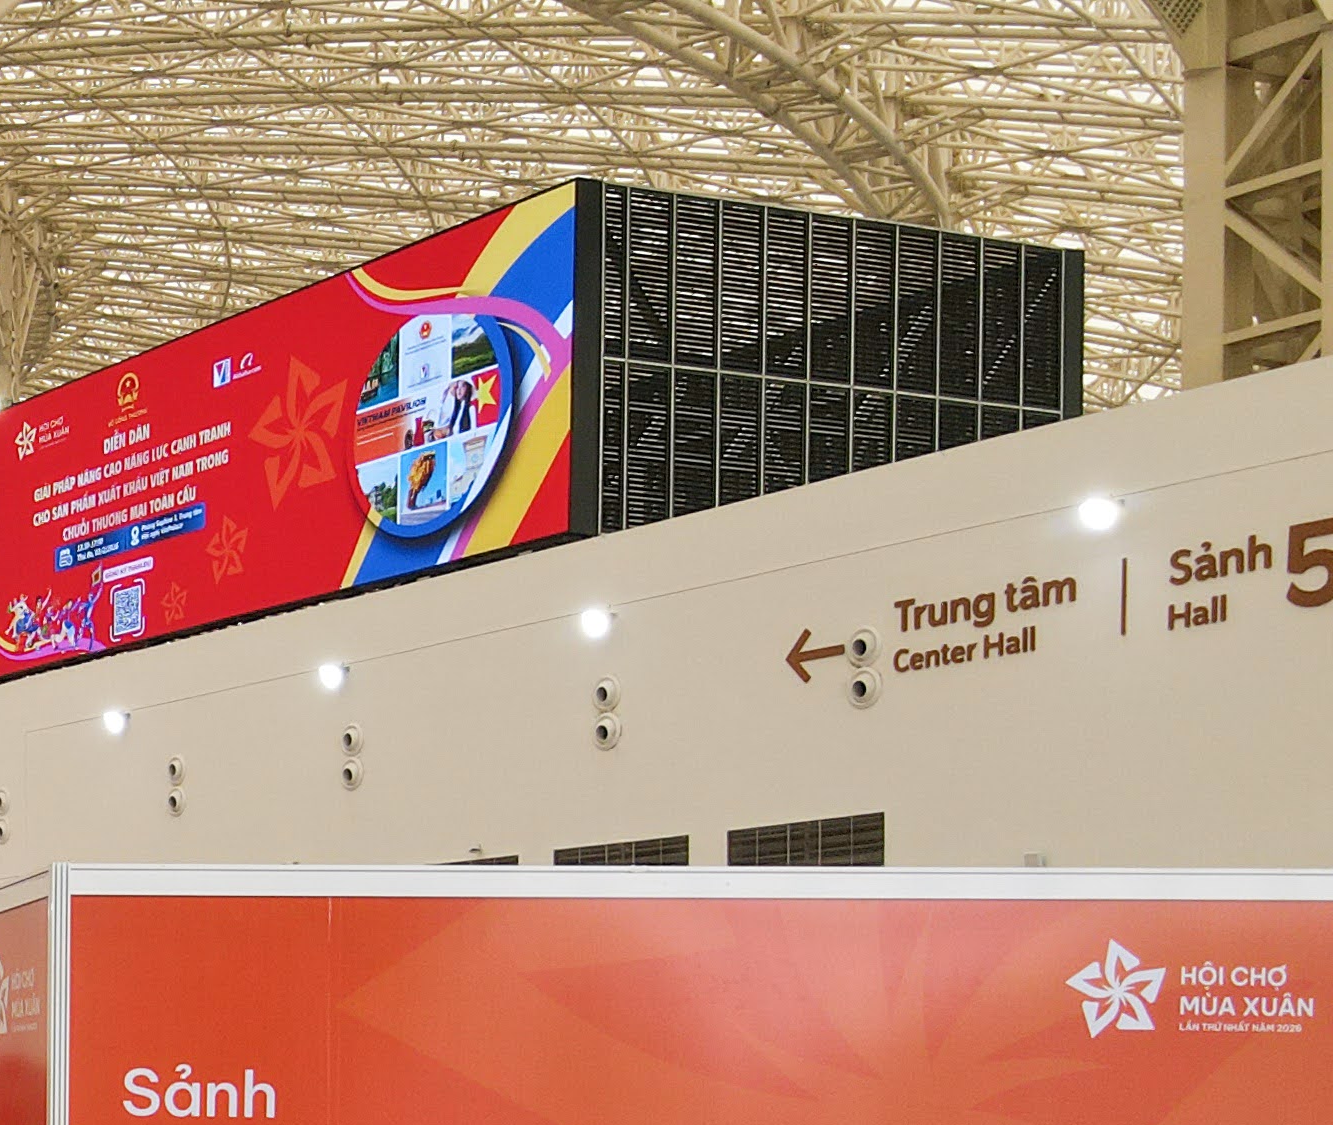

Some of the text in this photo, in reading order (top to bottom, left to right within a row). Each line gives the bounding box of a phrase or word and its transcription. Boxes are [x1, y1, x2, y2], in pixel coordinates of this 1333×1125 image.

[104, 461, 122, 479] CAO
[198, 421, 231, 446] TRANH
[33, 510, 51, 528] CHO
[171, 461, 194, 481] NAM
[196, 448, 229, 474] TRONG
[1169, 534, 1272, 587] Sảnh
[894, 576, 1077, 633] Trung tâm
[1167, 594, 1228, 632] Hall
[893, 625, 1037, 674] Center Hall
[1180, 961, 1287, 991] HỘI CHỢ
[1179, 991, 1314, 1017] MÙA XUÂN
[122, 1063, 276, 1119] Sảnh
